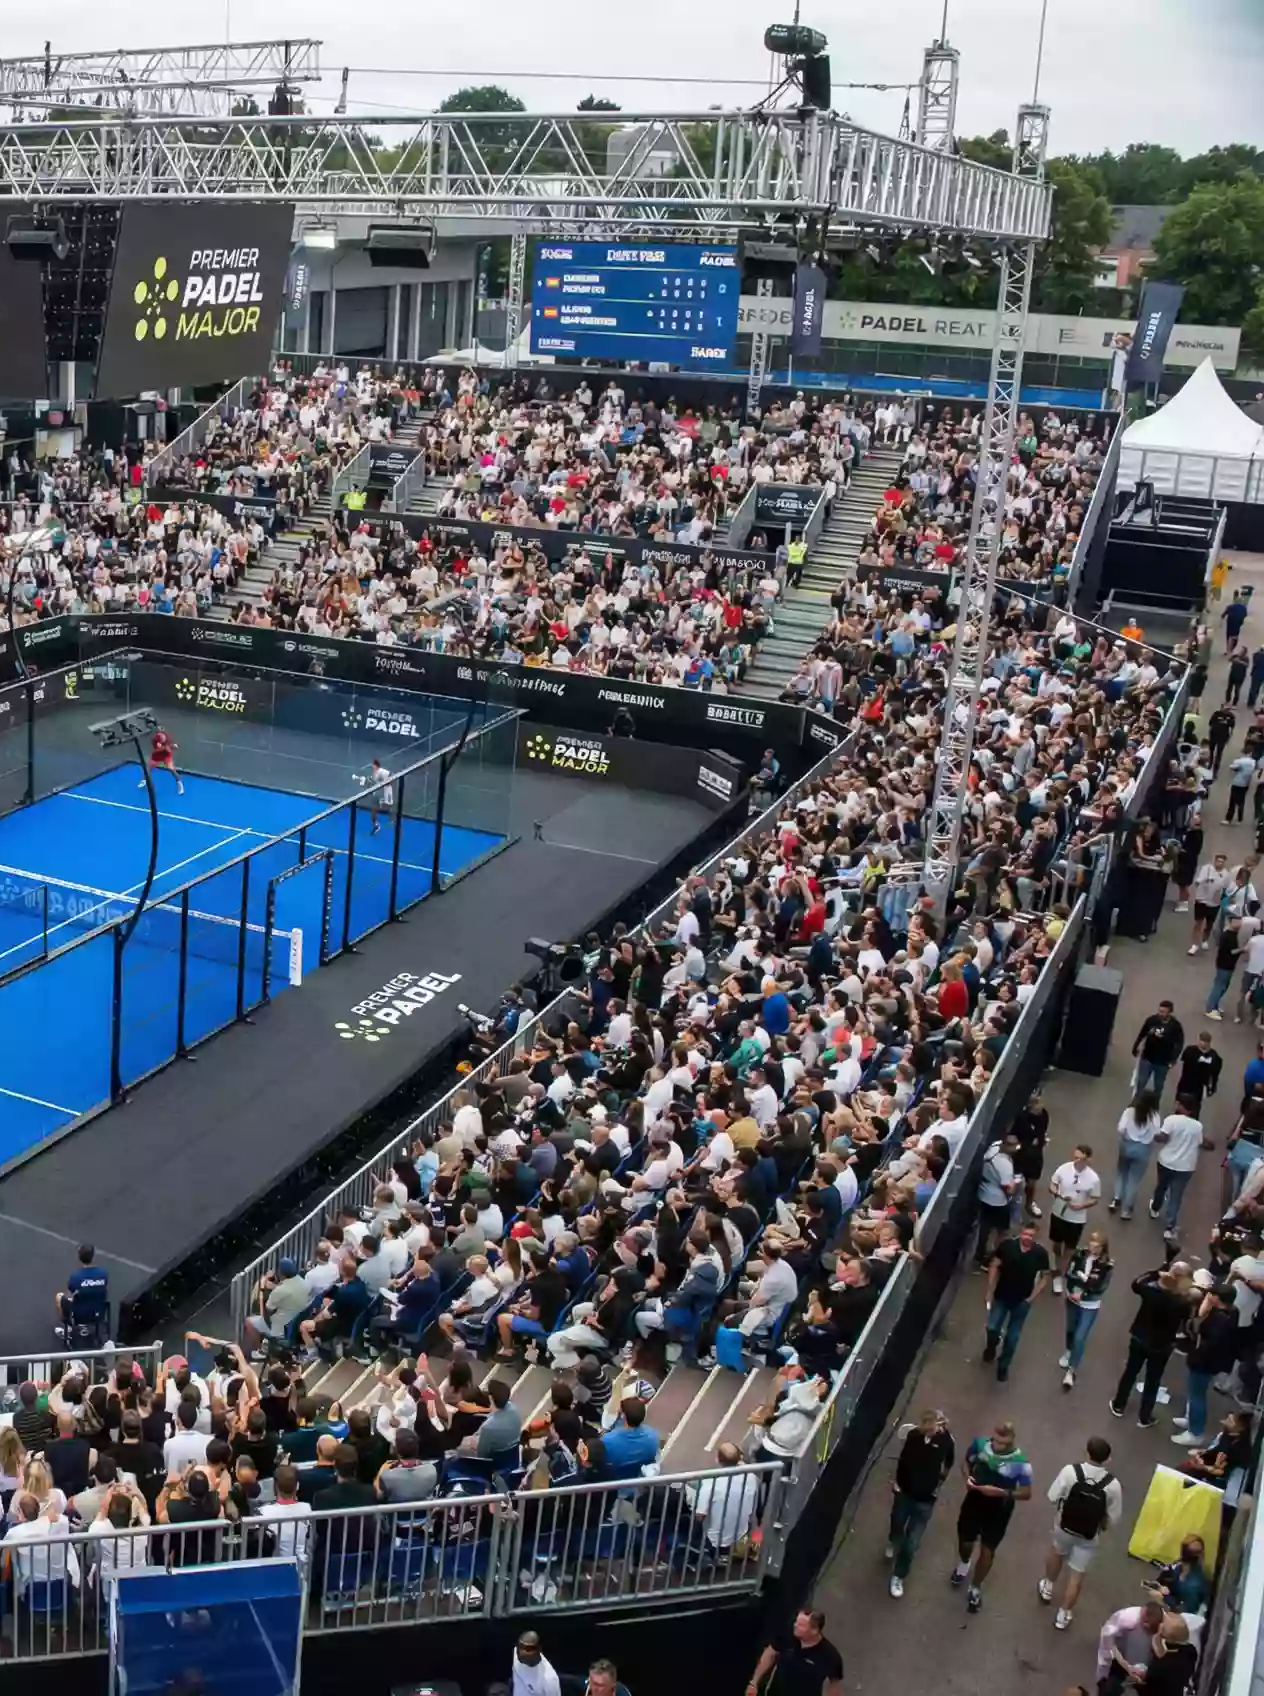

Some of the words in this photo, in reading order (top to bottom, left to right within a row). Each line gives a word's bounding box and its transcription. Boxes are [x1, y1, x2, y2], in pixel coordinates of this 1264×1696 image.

[189, 247, 260, 270] PREMIER
[181, 272, 263, 308] PADEL
[175, 306, 260, 341] MAJOR
[861, 315, 927, 333] PADEL
[199, 686, 248, 703] PADEL
[365, 717, 421, 737] PADEL
[554, 744, 611, 763] PADEL
[552, 756, 609, 774] MAJOR
[351, 972, 420, 1016] PREMIER
[373, 972, 463, 1025] PADEL
